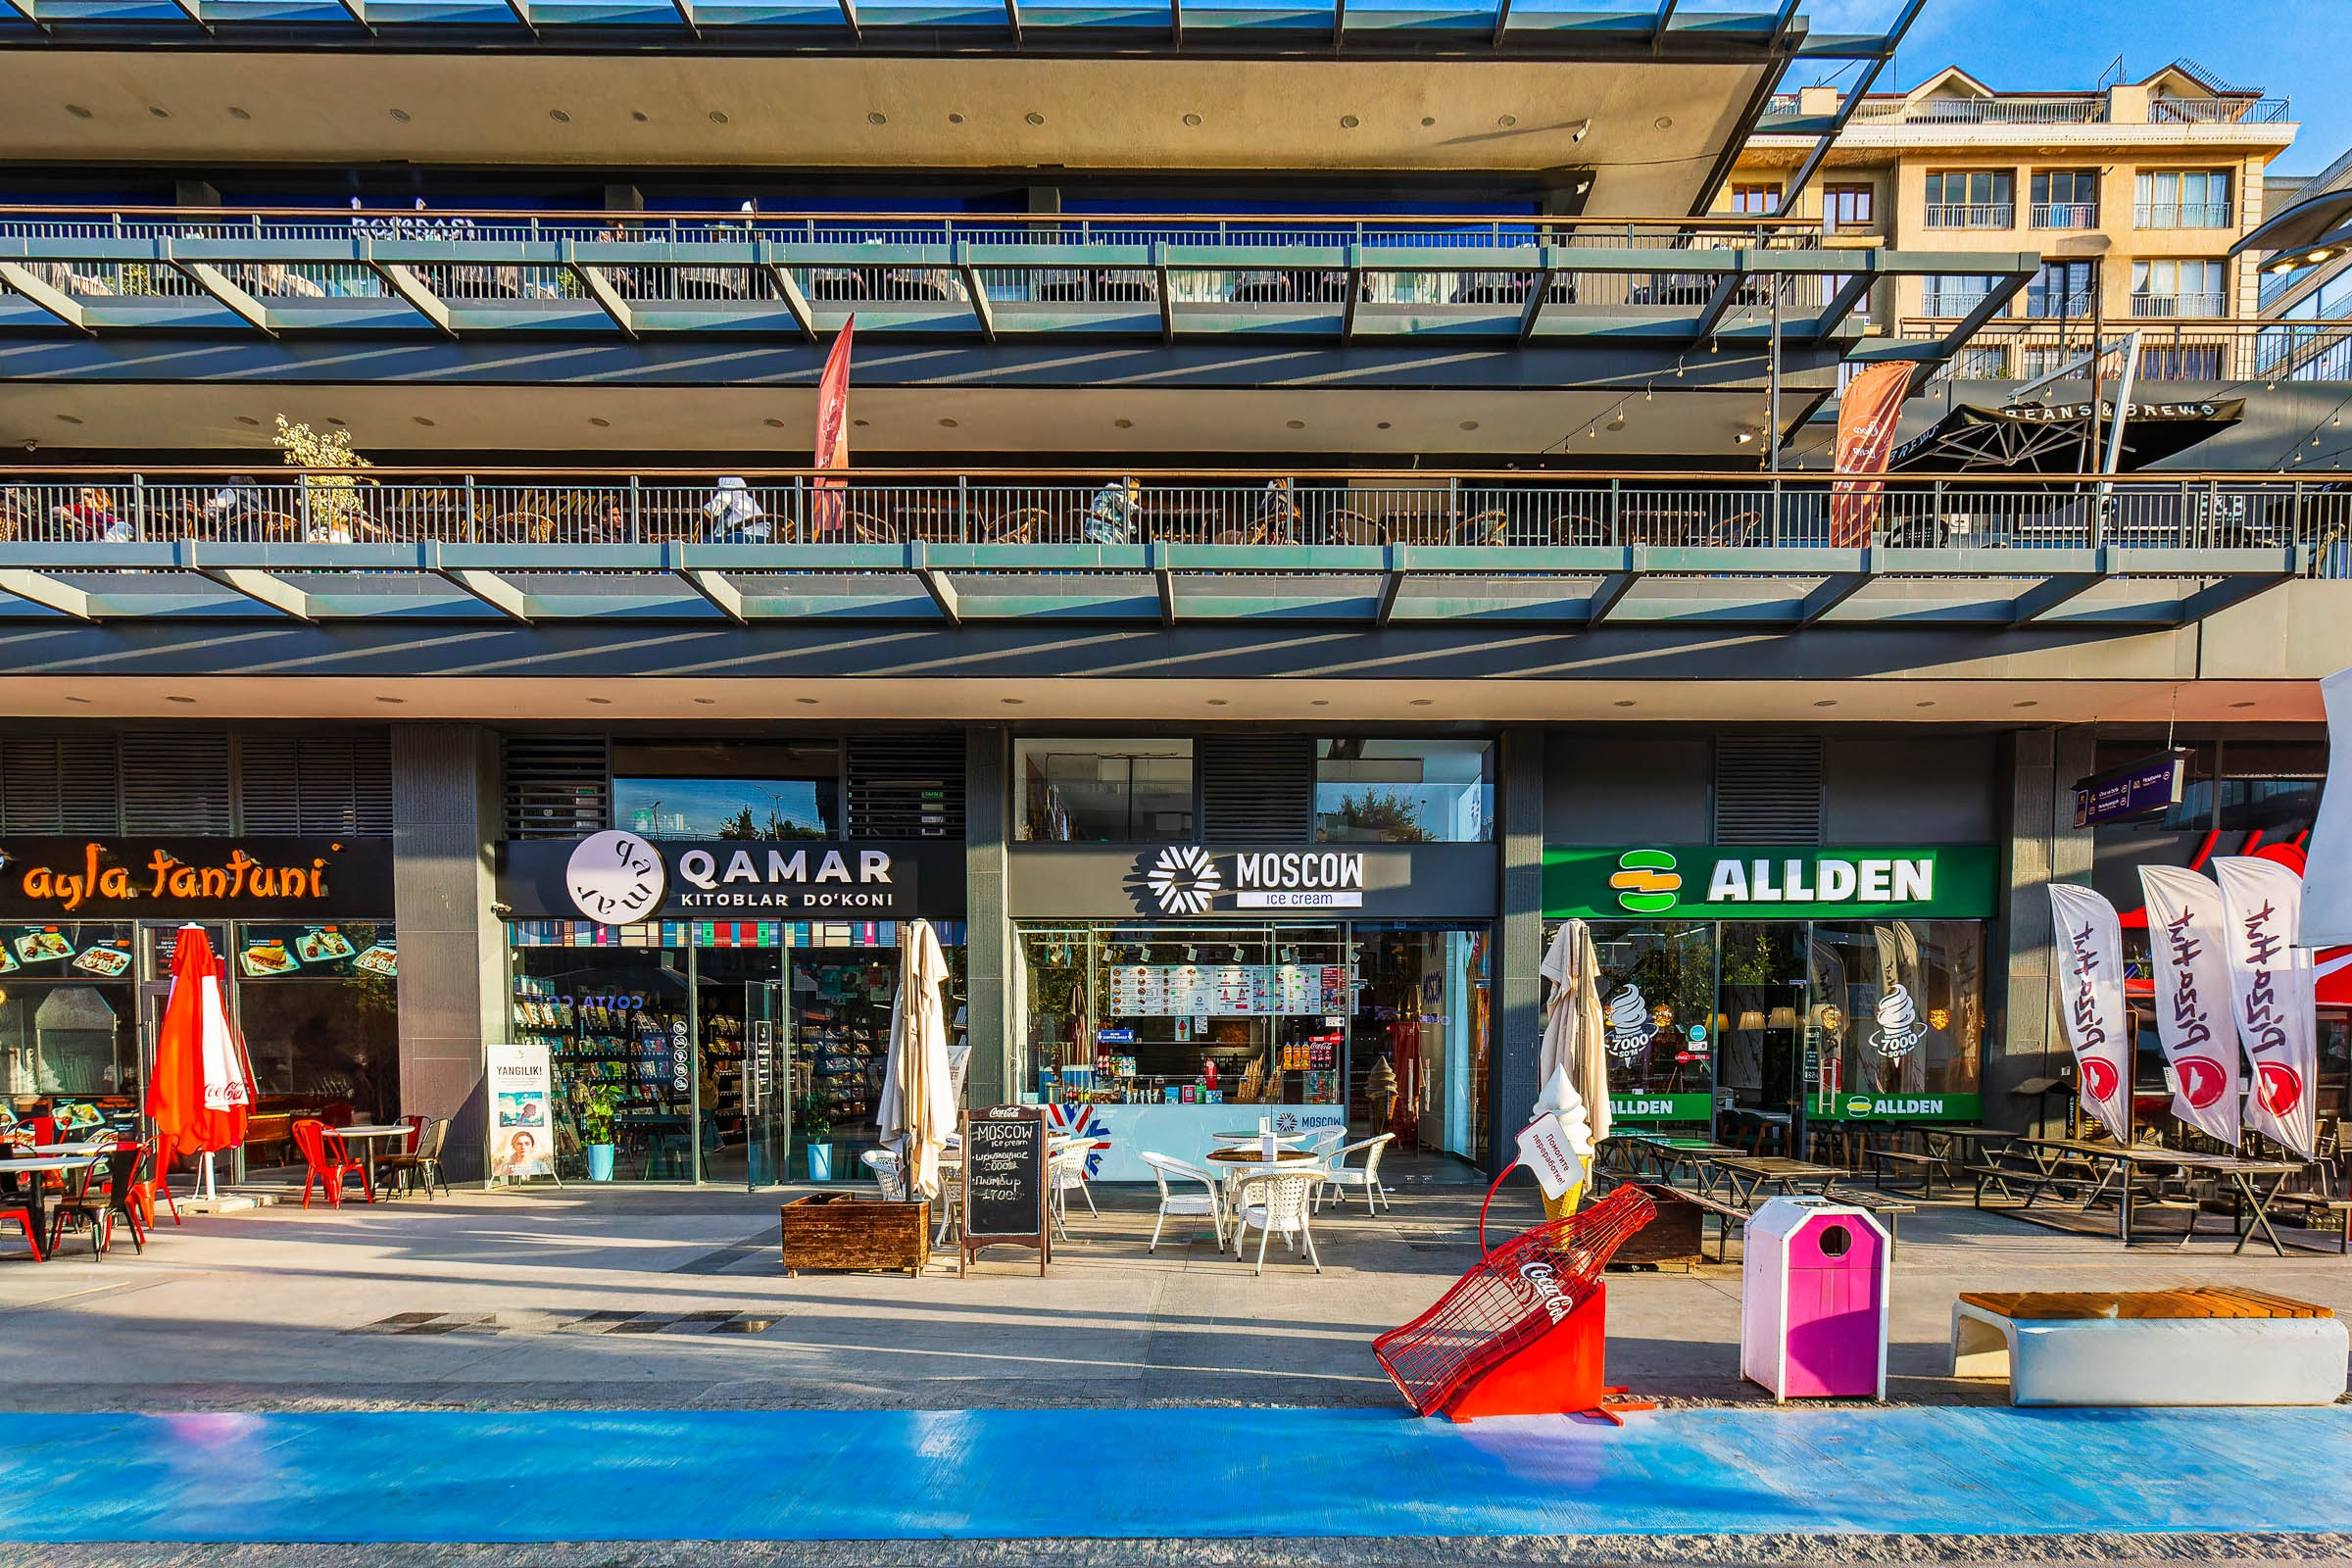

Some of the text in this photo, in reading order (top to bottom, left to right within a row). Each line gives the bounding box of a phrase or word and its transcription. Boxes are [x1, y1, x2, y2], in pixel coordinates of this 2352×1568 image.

[2125, 403, 2215, 417] BREWS
[23, 843, 327, 910] ayla tantuni
[576, 839, 654, 915] qamar
[679, 849, 893, 889] QAMAR
[1237, 852, 1364, 888] MOSCOW
[1707, 858, 1934, 903] ALLDEN
[681, 893, 789, 906] KITOBLAR
[1291, 893, 1333, 905] cream
[1611, 1033, 1649, 1051] 7000
[1881, 1033, 1918, 1052] 7000
[496, 1065, 543, 1076] YANGILIK!
[1874, 1100, 1942, 1114] ALLDEN
[1301, 1116, 1342, 1128] MOSCOW
[978, 1124, 1033, 1141] MOSCOW
[1532, 1133, 1566, 1186] переработке!
[1545, 1133, 1570, 1172] Помогите
